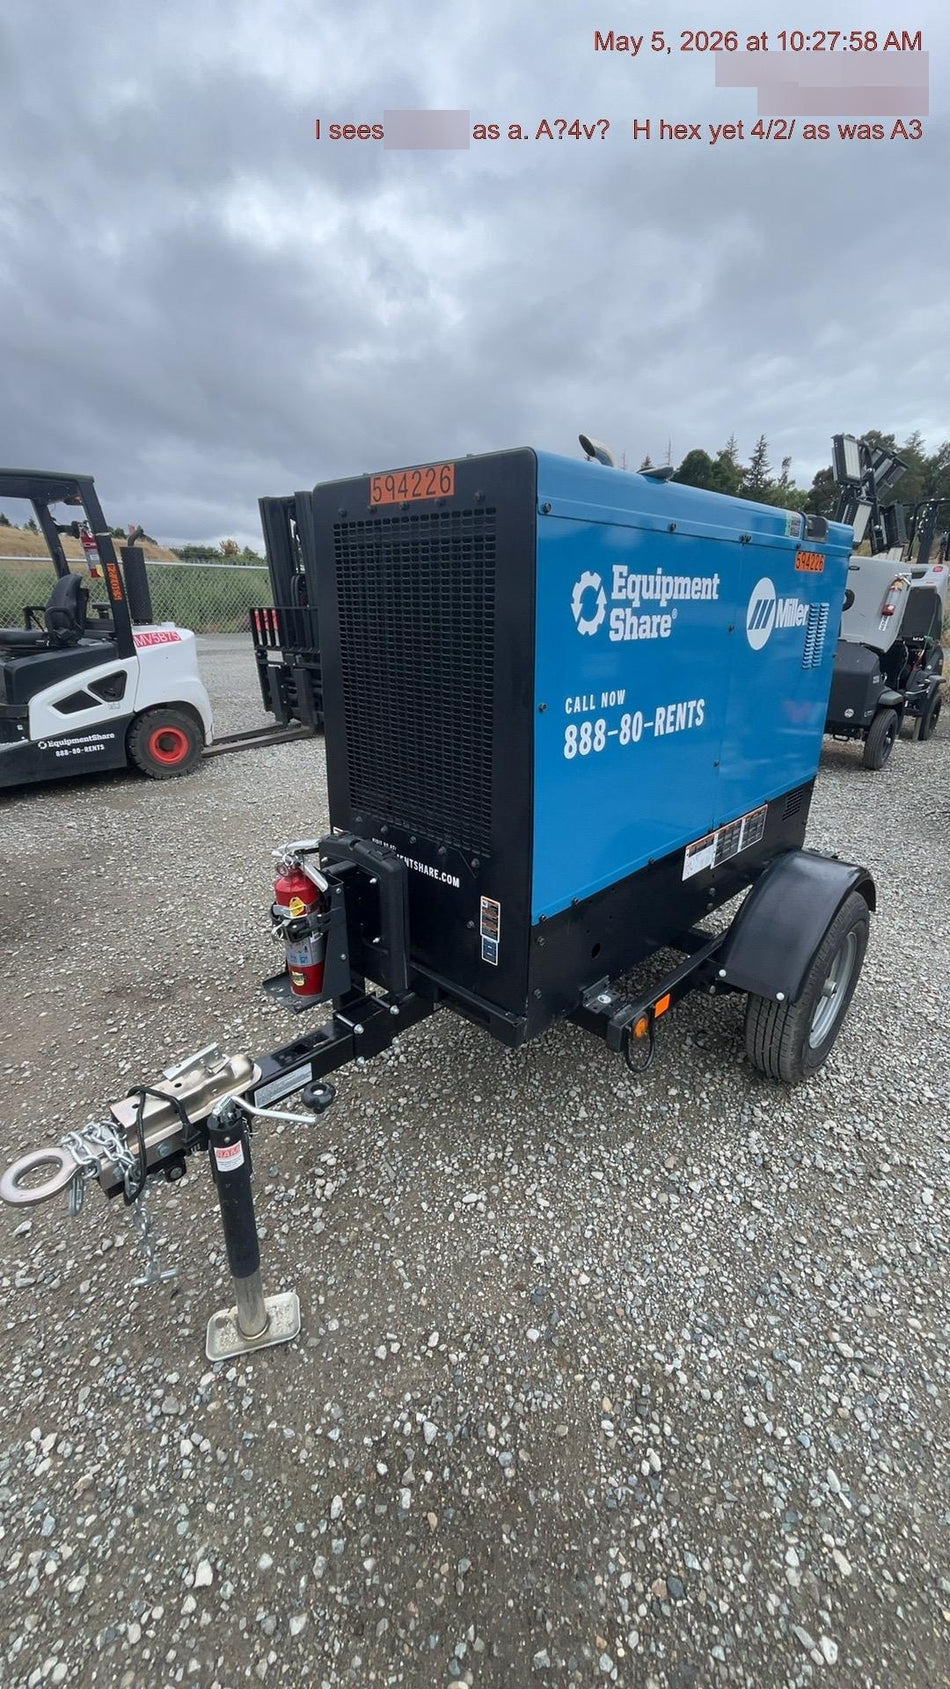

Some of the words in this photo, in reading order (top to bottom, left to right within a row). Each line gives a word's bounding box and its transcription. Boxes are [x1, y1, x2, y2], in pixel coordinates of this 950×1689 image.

[372, 465, 451, 502] 594226
[796, 551, 824, 571] 594226
[611, 564, 720, 607] Equipment
[775, 598, 810, 628] Miller
[565, 694, 596, 714] CALL
[601, 689, 626, 708] NOW
[48, 733, 115, 748] EquipmentShare
[563, 698, 705, 759] 888-80-RENTS
